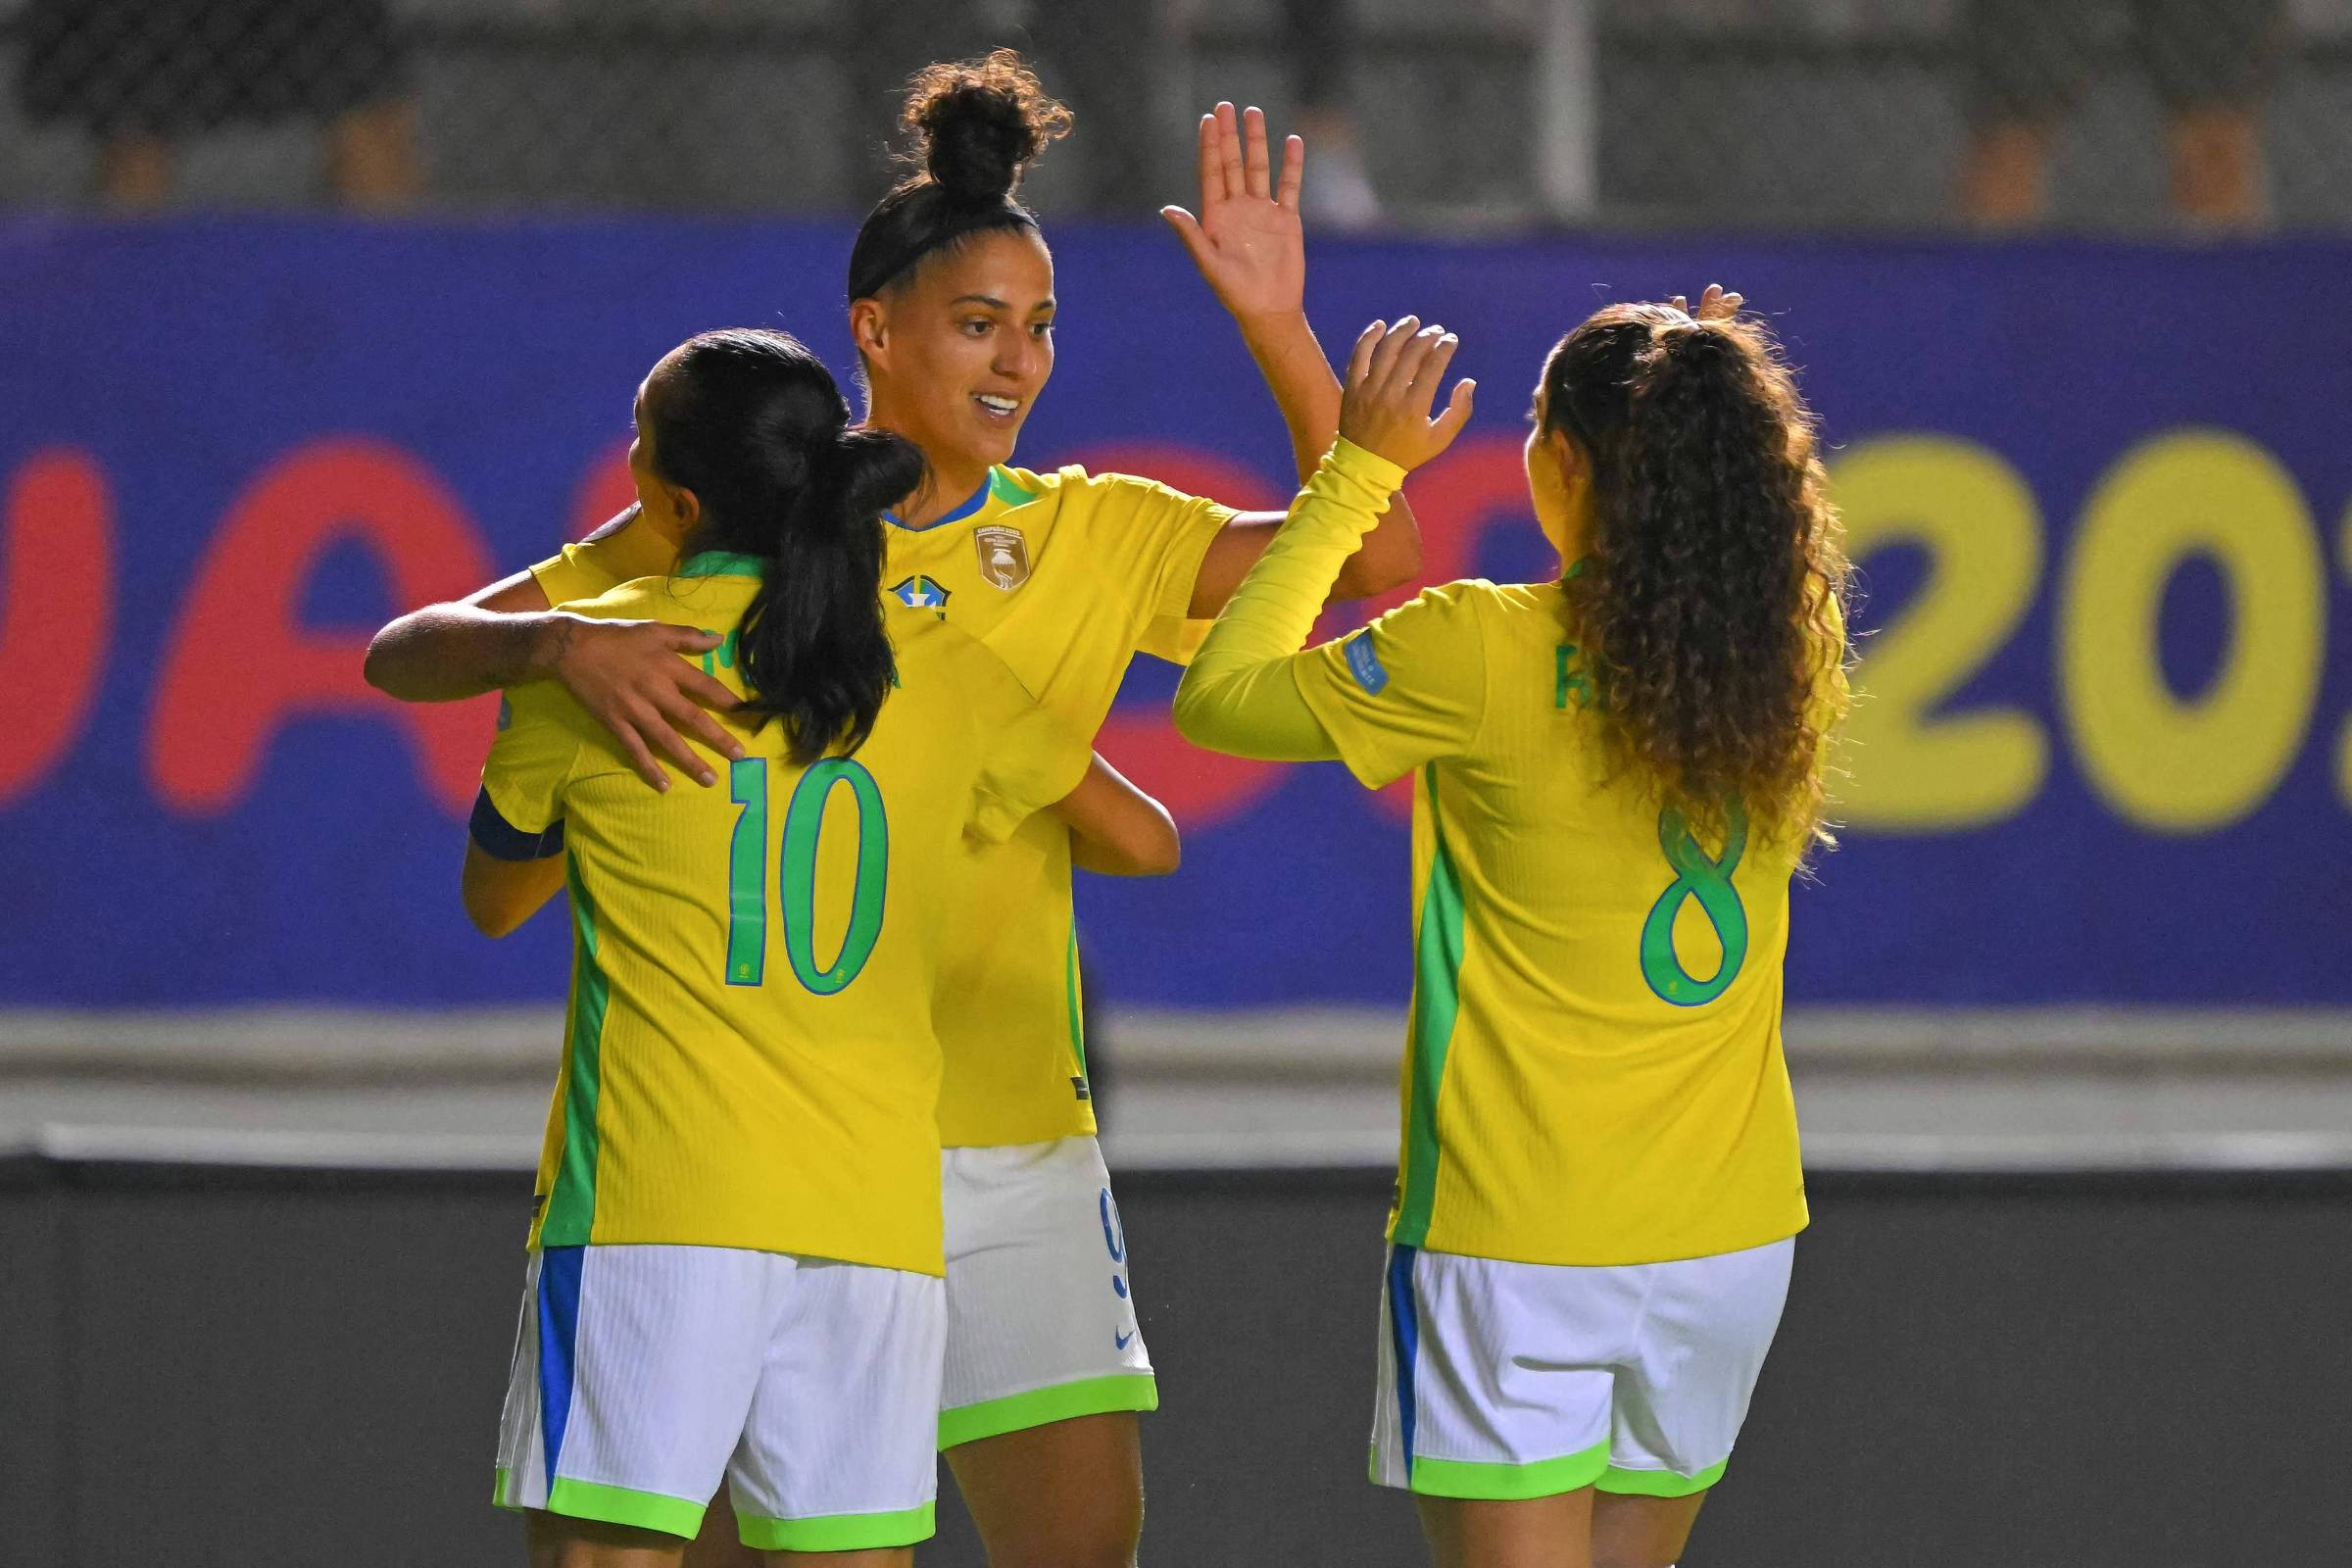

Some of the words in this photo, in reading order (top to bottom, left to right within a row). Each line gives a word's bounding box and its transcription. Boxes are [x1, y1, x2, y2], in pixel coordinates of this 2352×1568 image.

[1825, 429, 2352, 835] 20
[725, 756, 889, 996] 10
[1640, 784, 1749, 1006] 8
[1100, 1187, 1128, 1299] 9
